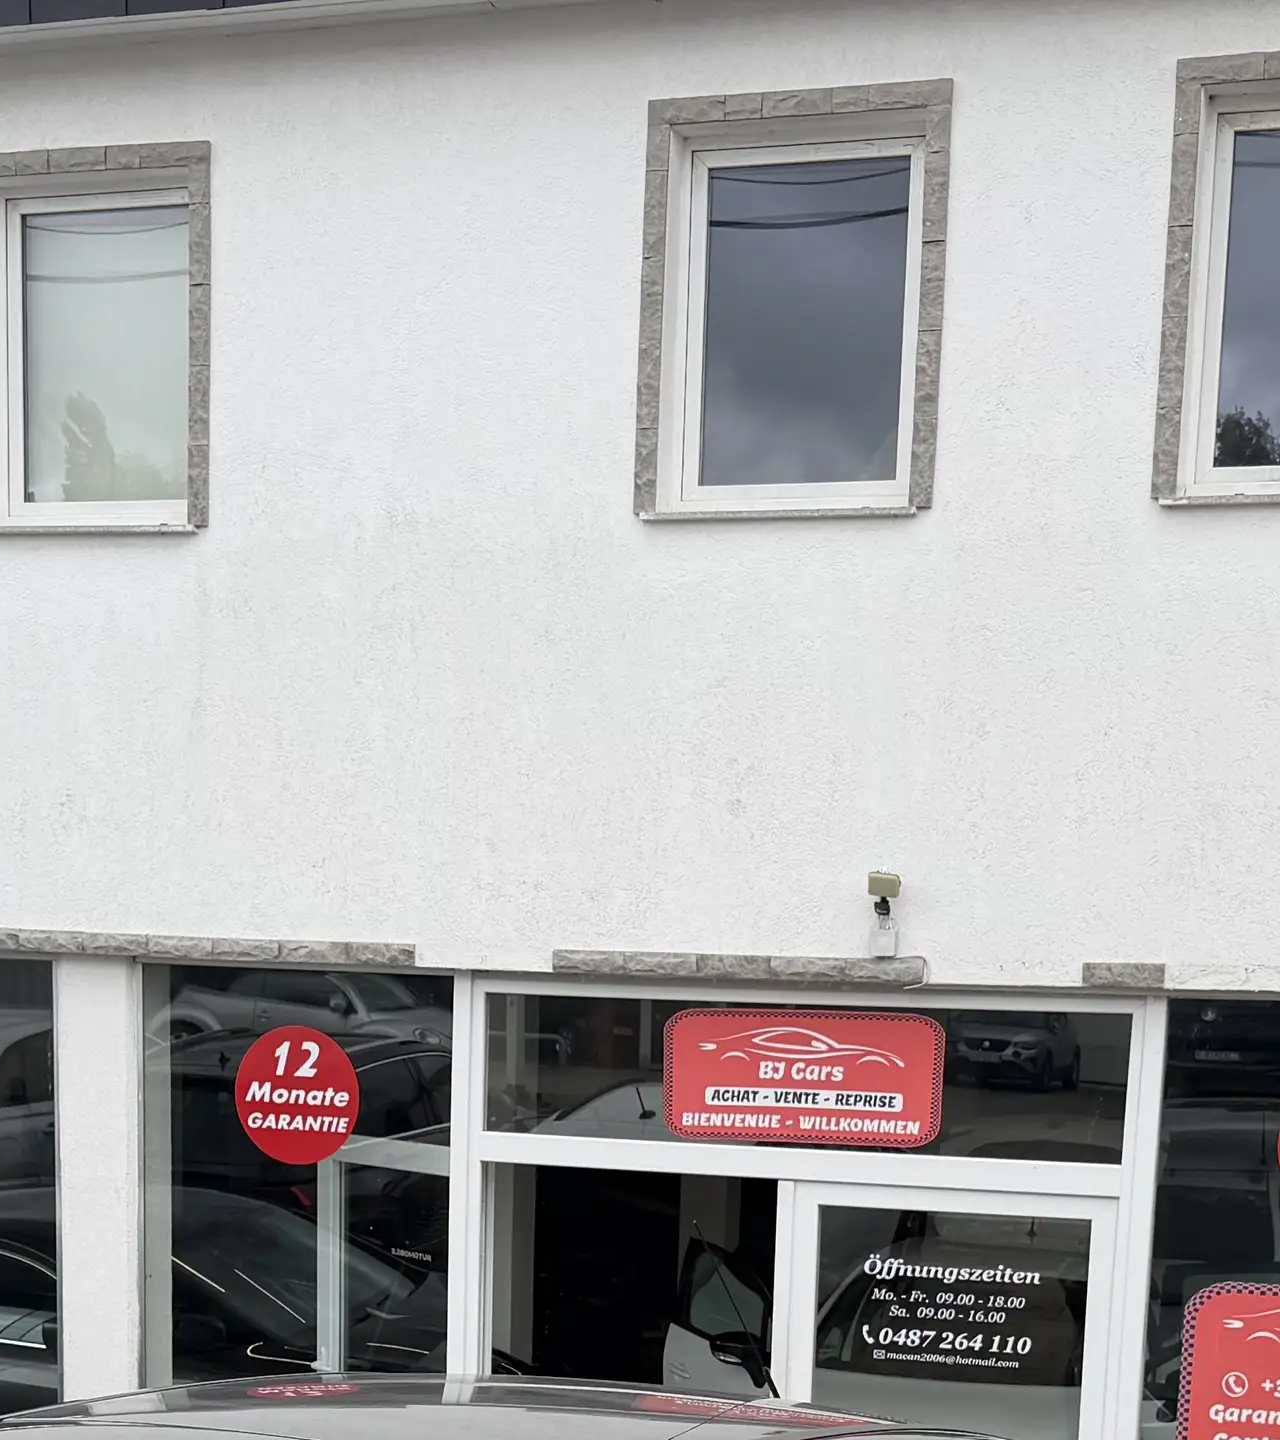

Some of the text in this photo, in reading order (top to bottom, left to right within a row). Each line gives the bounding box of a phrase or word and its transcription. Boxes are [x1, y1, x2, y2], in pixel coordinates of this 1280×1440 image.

[274, 1041, 320, 1078] 12
[758, 1060, 845, 1082] BJ Cars
[245, 1081, 350, 1107] Monate
[710, 1089, 760, 1104] ACHAT
[773, 1091, 820, 1106] VENTE
[834, 1093, 897, 1109] REPRISE
[247, 1112, 350, 1134] GARANTIE
[681, 1112, 781, 1129] BIENVENUE
[799, 1115, 920, 1136] WILLKOMMEN
[863, 1253, 1041, 1285] Öffnungszeiten
[871, 1288, 897, 1301] Mo.
[909, 1291, 929, 1303] Fr.
[936, 1292, 975, 1306] 09.00
[987, 1295, 1026, 1309] 18.00
[888, 1305, 910, 1318] Sa.
[916, 1307, 955, 1320] 09.00
[968, 1310, 1006, 1324] 16.00
[878, 1327, 1032, 1355] 0487 264 110
[886, 1351, 1019, 1369] macan2006@hotmail.com
